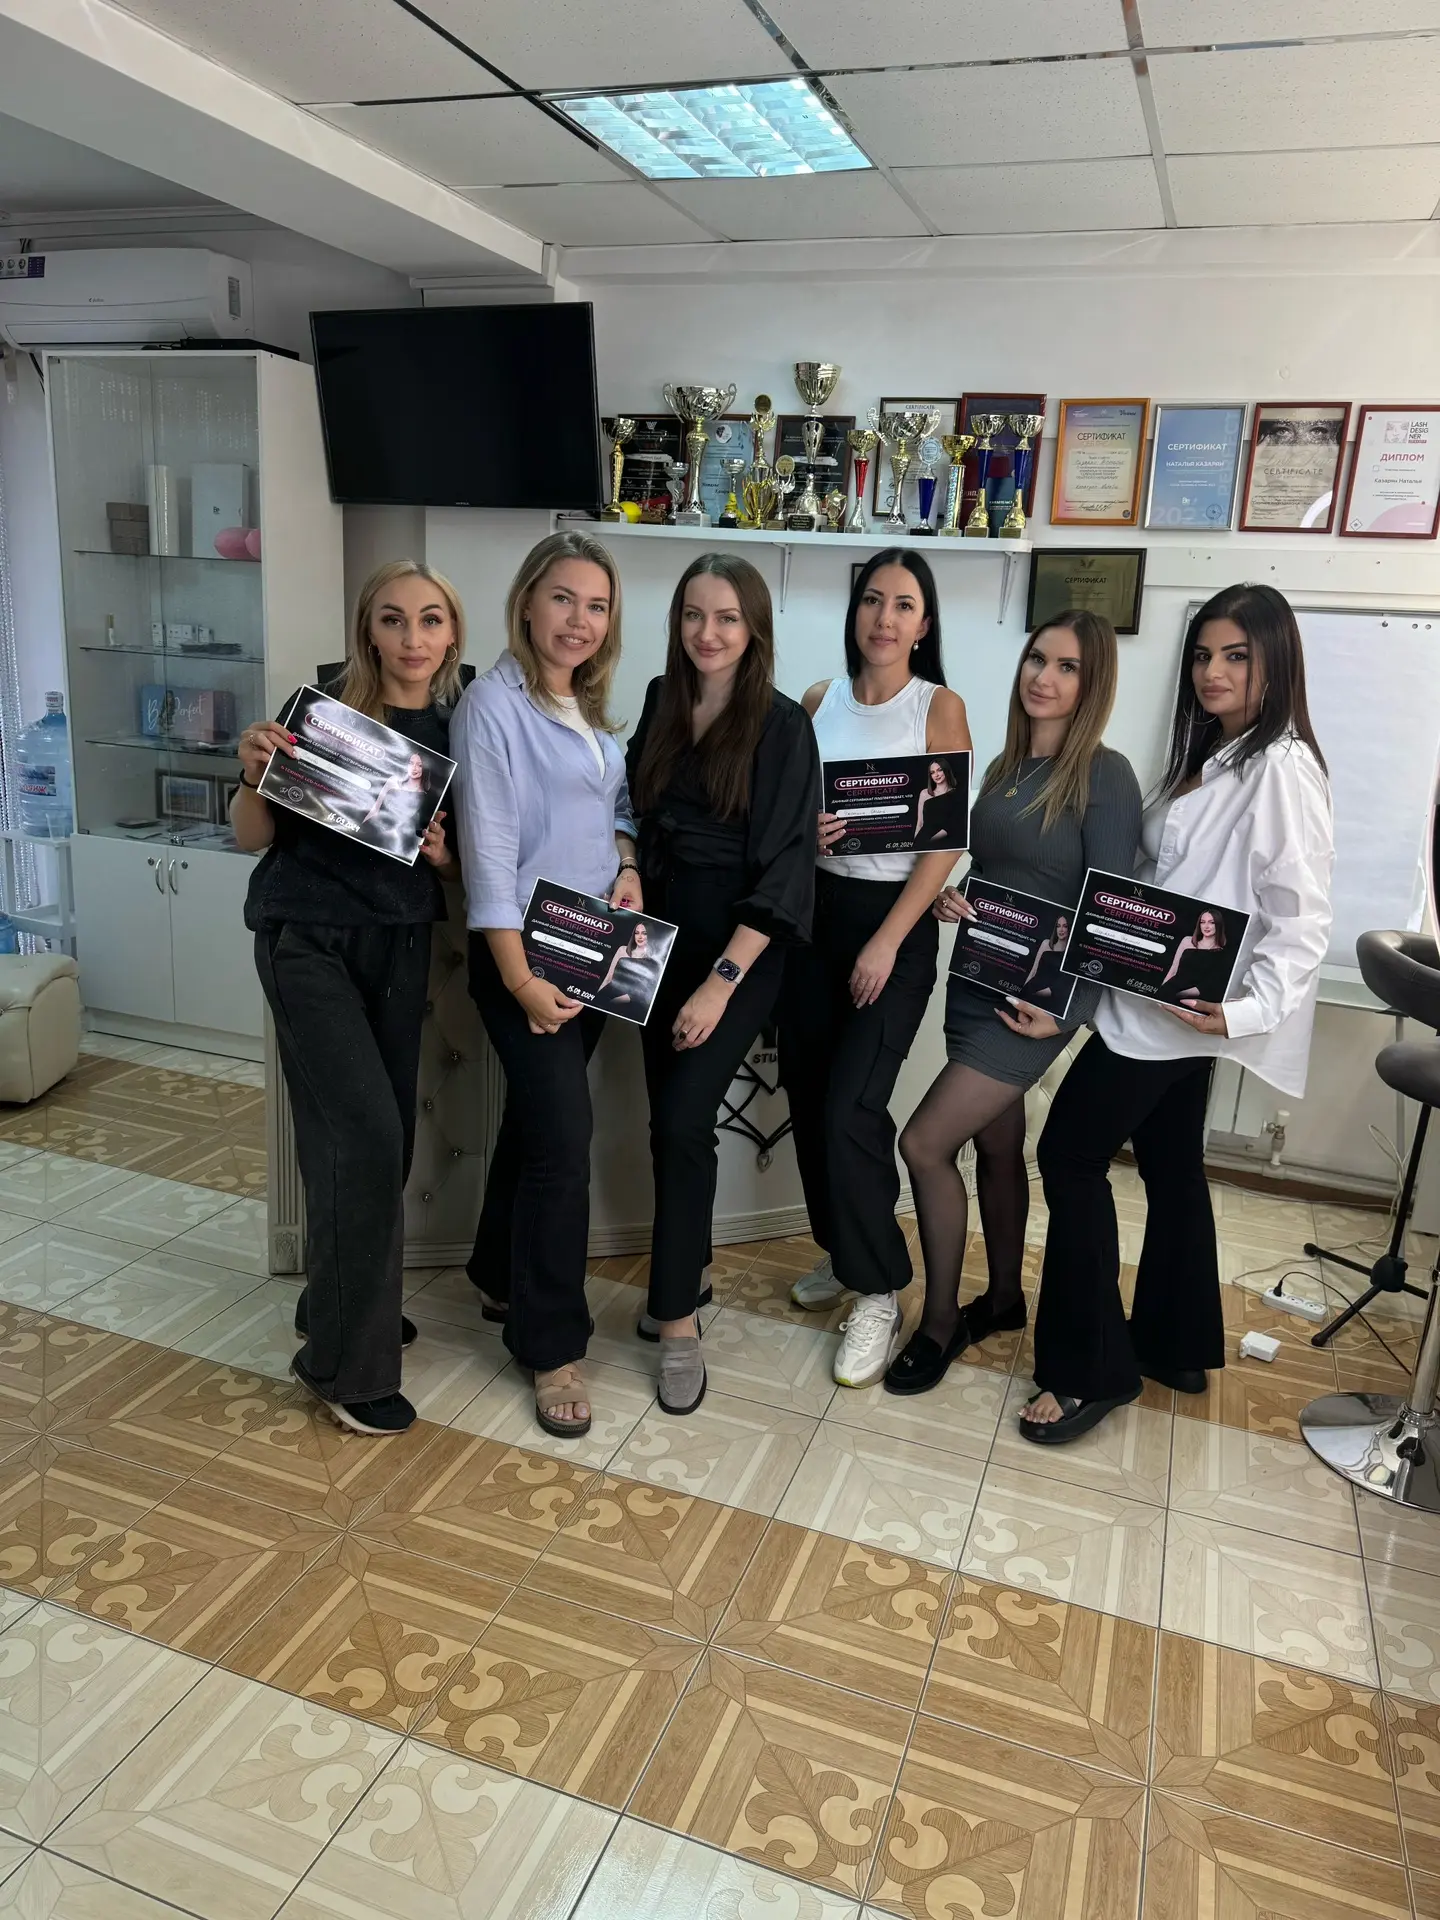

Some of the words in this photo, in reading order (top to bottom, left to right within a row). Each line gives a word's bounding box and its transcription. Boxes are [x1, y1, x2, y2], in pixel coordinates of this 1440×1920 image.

[1167, 443, 1227, 451] СЕРТИФИКАТ
[310, 716, 380, 756] СЕРТИФИКАТ
[839, 776, 903, 787] СЕРТИФИКАТ
[847, 787, 897, 796] CERTIFICATE
[545, 903, 609, 931] СЕРТИФИКАТ
[978, 901, 1034, 925] СЕРТИФИКАТ
[1099, 894, 1171, 921] СЕРТИФИКАТ
[1103, 907, 1160, 928] CERTIFICATE
[548, 915, 599, 938] CERTIFICATE
[1126, 977, 1159, 993] 15.09.2024
[753, 1053, 777, 1064] STU
